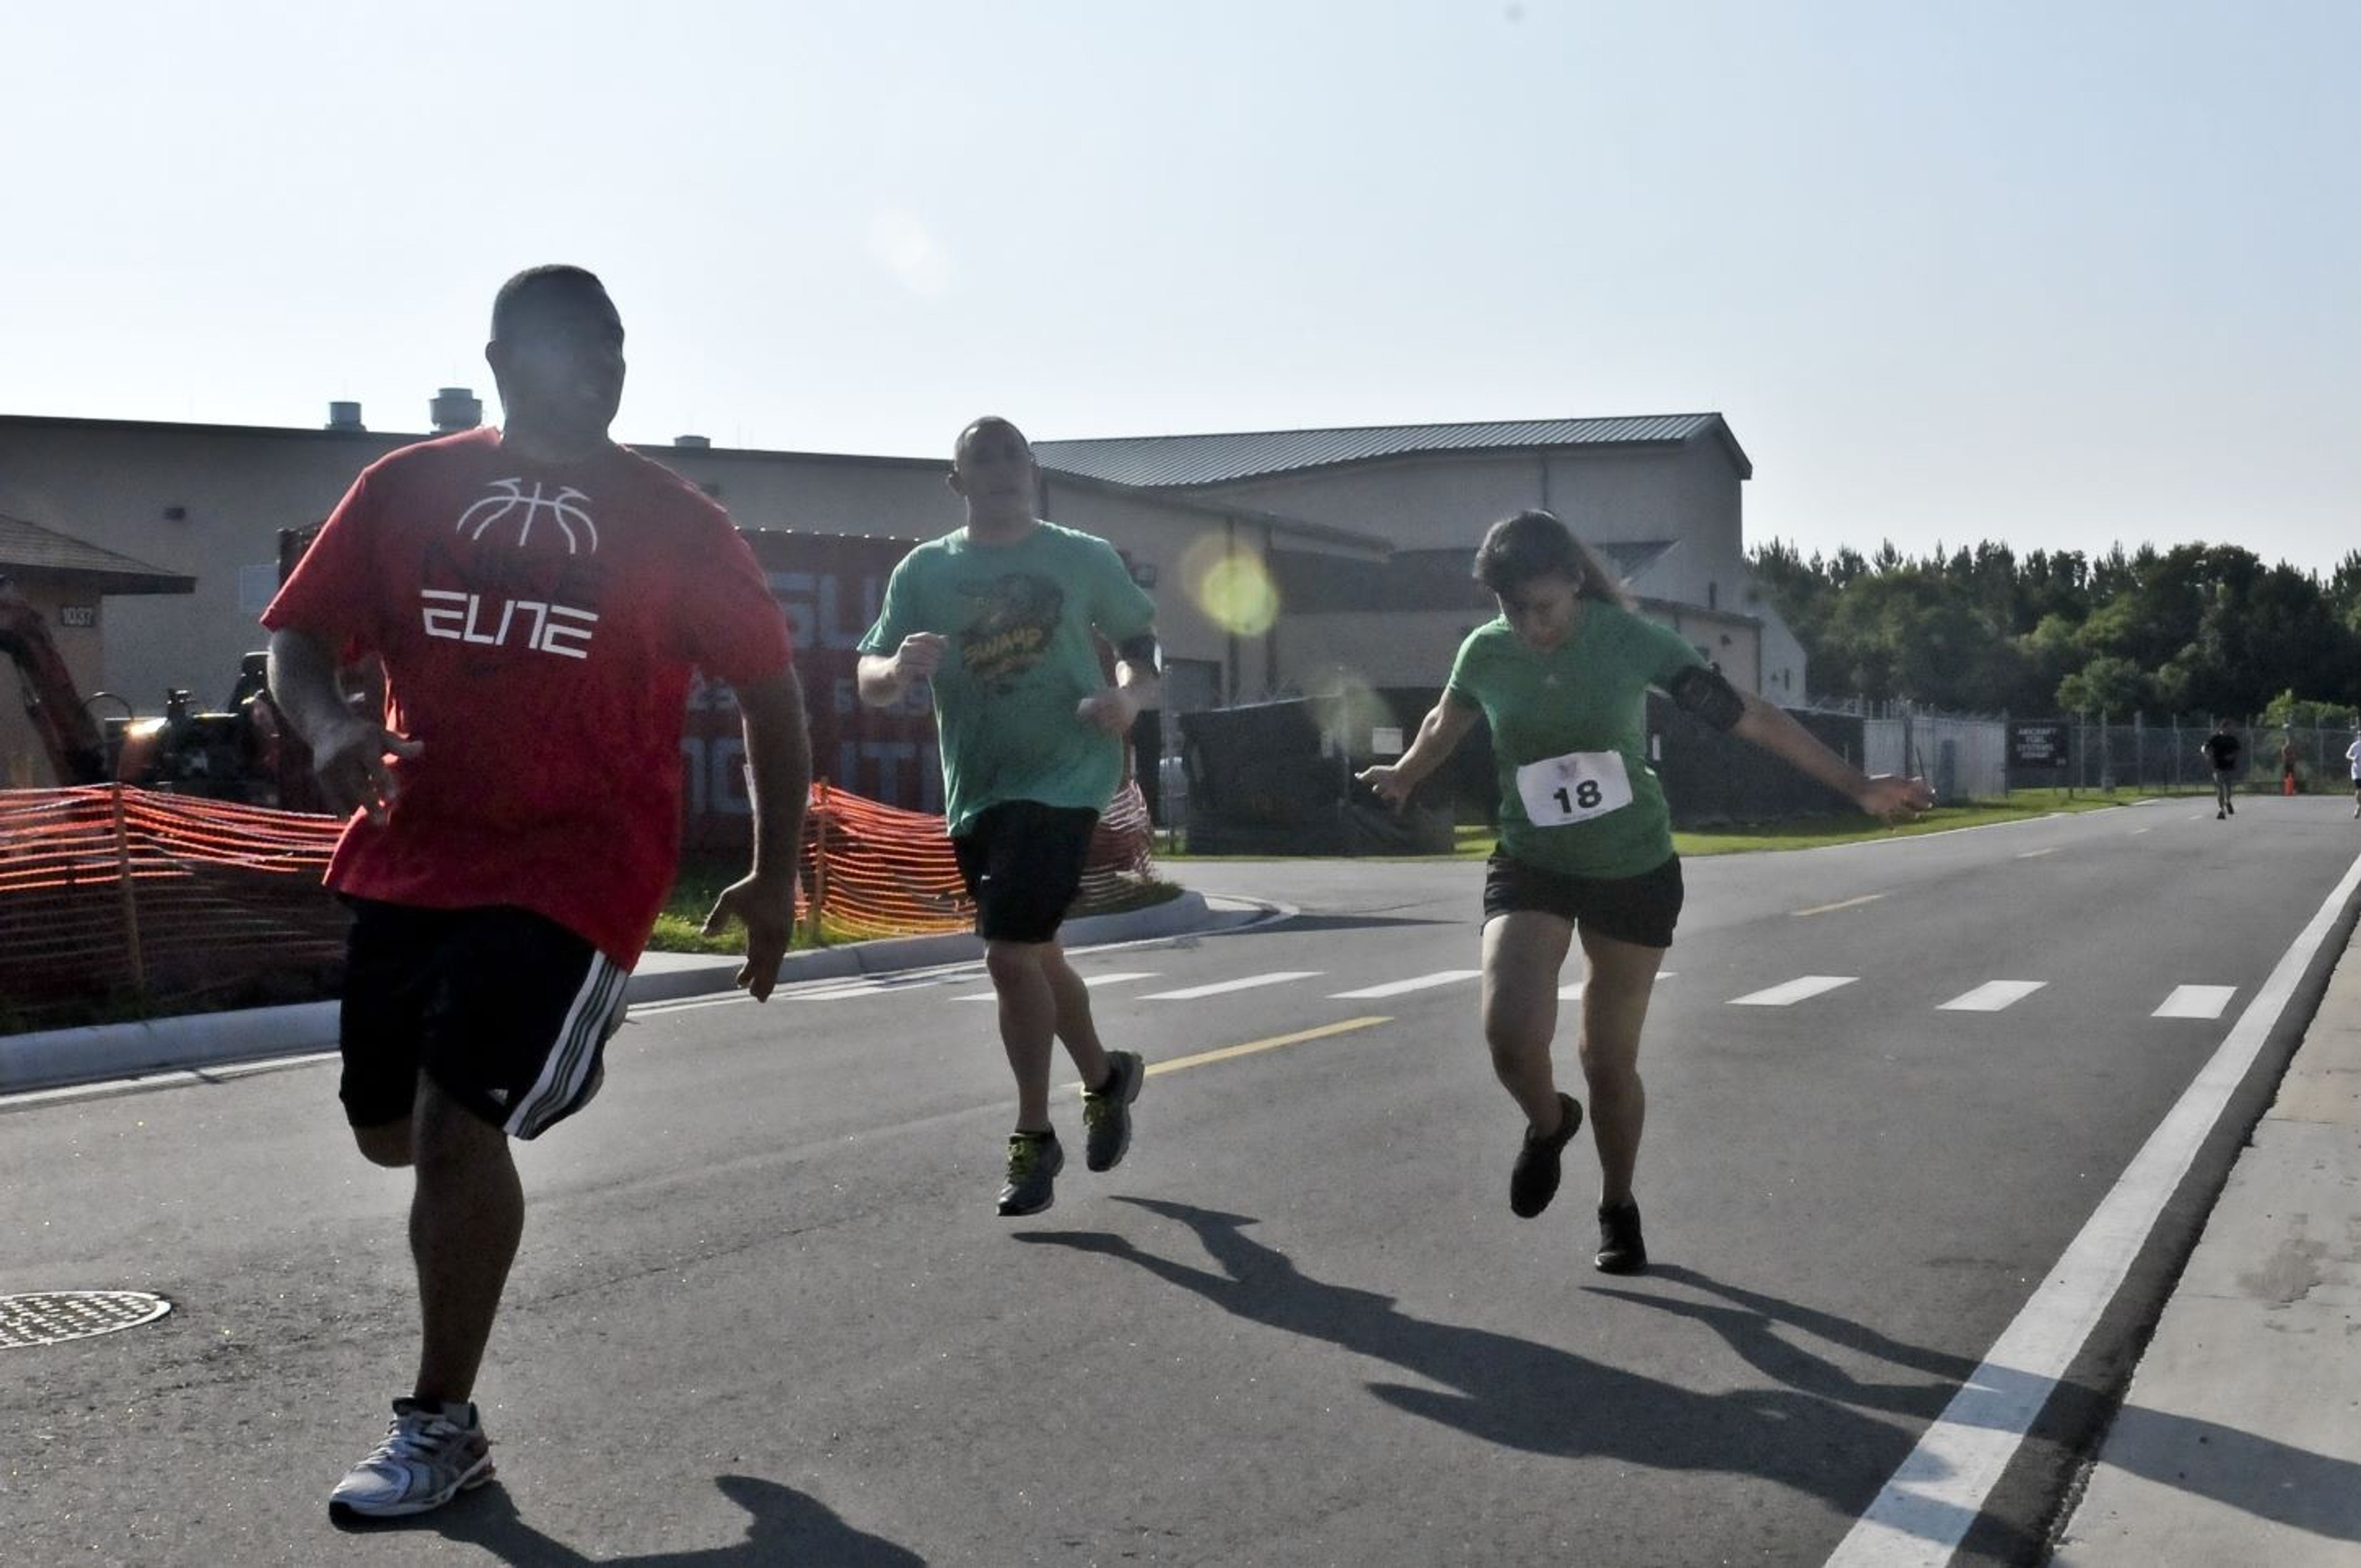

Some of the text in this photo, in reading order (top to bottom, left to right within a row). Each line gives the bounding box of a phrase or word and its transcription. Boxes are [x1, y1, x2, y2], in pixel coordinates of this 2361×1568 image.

[63, 607, 92, 625] 1037
[421, 589, 600, 659] ELITE
[1554, 780, 1602, 813] 18
